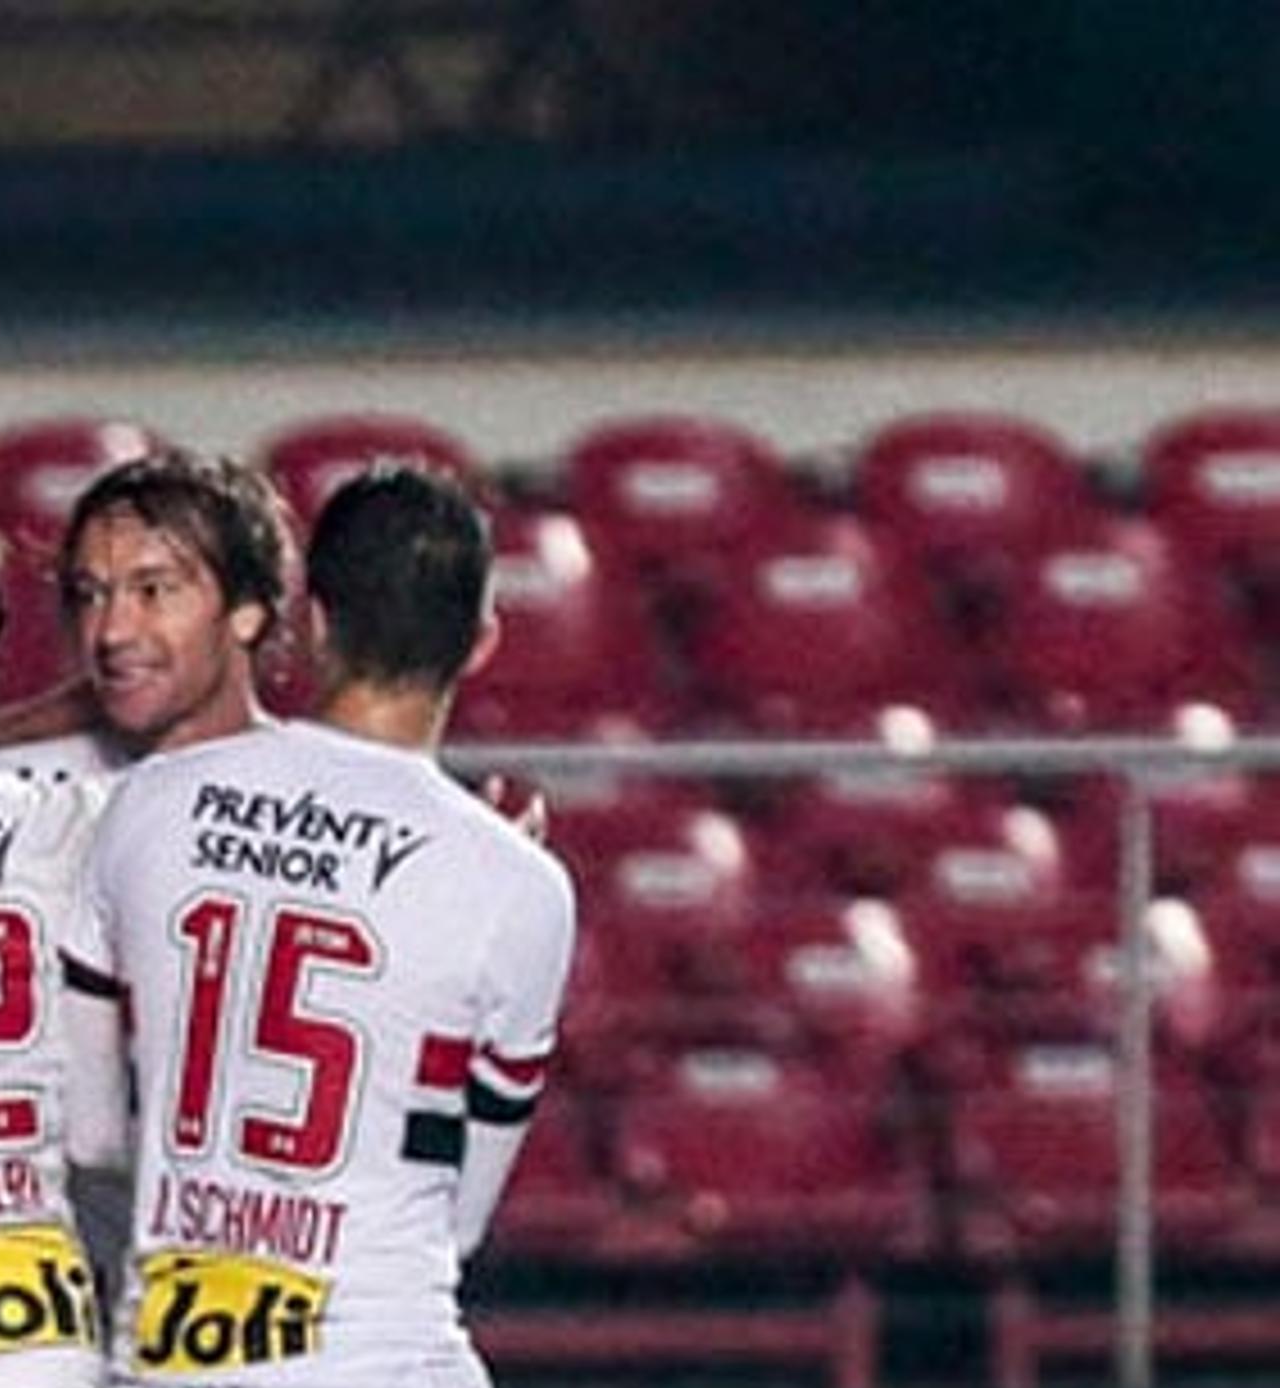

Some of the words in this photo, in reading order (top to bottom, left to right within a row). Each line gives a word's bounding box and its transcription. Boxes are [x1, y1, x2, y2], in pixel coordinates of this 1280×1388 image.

[192, 784, 386, 850] PREVENT
[192, 830, 339, 892] SENIOR
[169, 892, 378, 1168] 15
[137, 1280, 313, 1367] Joli
